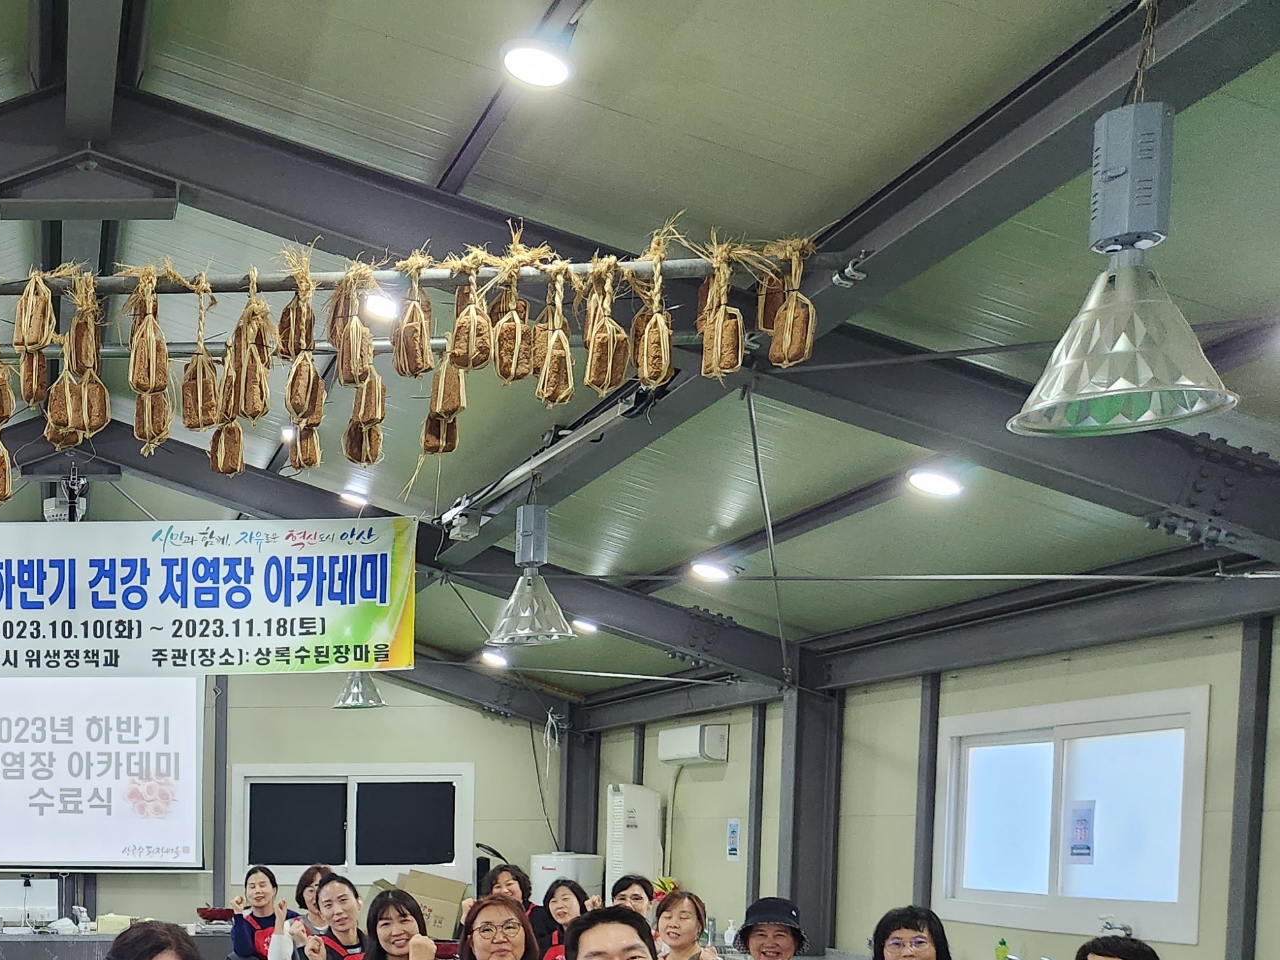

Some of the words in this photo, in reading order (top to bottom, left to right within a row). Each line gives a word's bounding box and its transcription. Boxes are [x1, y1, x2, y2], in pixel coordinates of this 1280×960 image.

[151, 525, 198, 552] 시민과
[234, 530, 280, 553] 자유로운
[284, 529, 336, 551] 혁신도시
[339, 527, 381, 546] 안산
[87, 557, 151, 611] 건강
[158, 555, 255, 610] 저염장
[263, 552, 388, 608] 아카데미
[171, 616, 327, 639] 2023.11.18(토)
[24, 648, 121, 669] 위생정책과
[253, 642, 391, 666] 상록수된장마을
[85, 715, 170, 745] 하반기
[67, 750, 181, 781] 아카데미
[28, 786, 113, 816] 수료식
